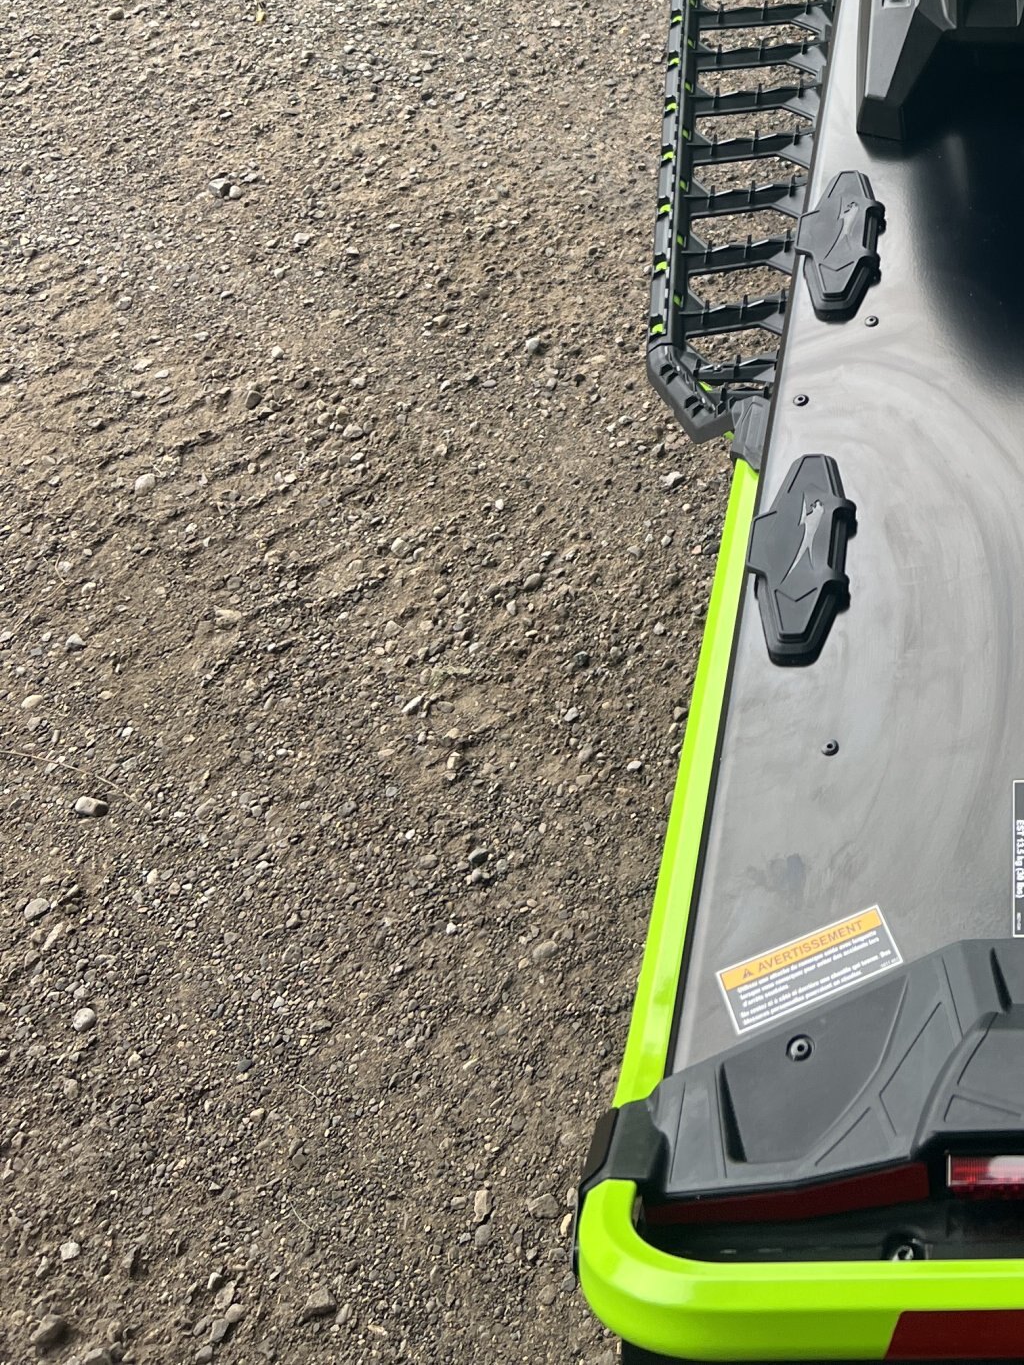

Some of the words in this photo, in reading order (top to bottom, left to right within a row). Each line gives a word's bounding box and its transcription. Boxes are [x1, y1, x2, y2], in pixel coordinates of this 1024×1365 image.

[1016, 819, 1024, 836] EST
[1016, 837, 1024, 854] 13.5
[1014, 855, 1024, 866] kg
[755, 918, 864, 973] AVERTISSEMENT
